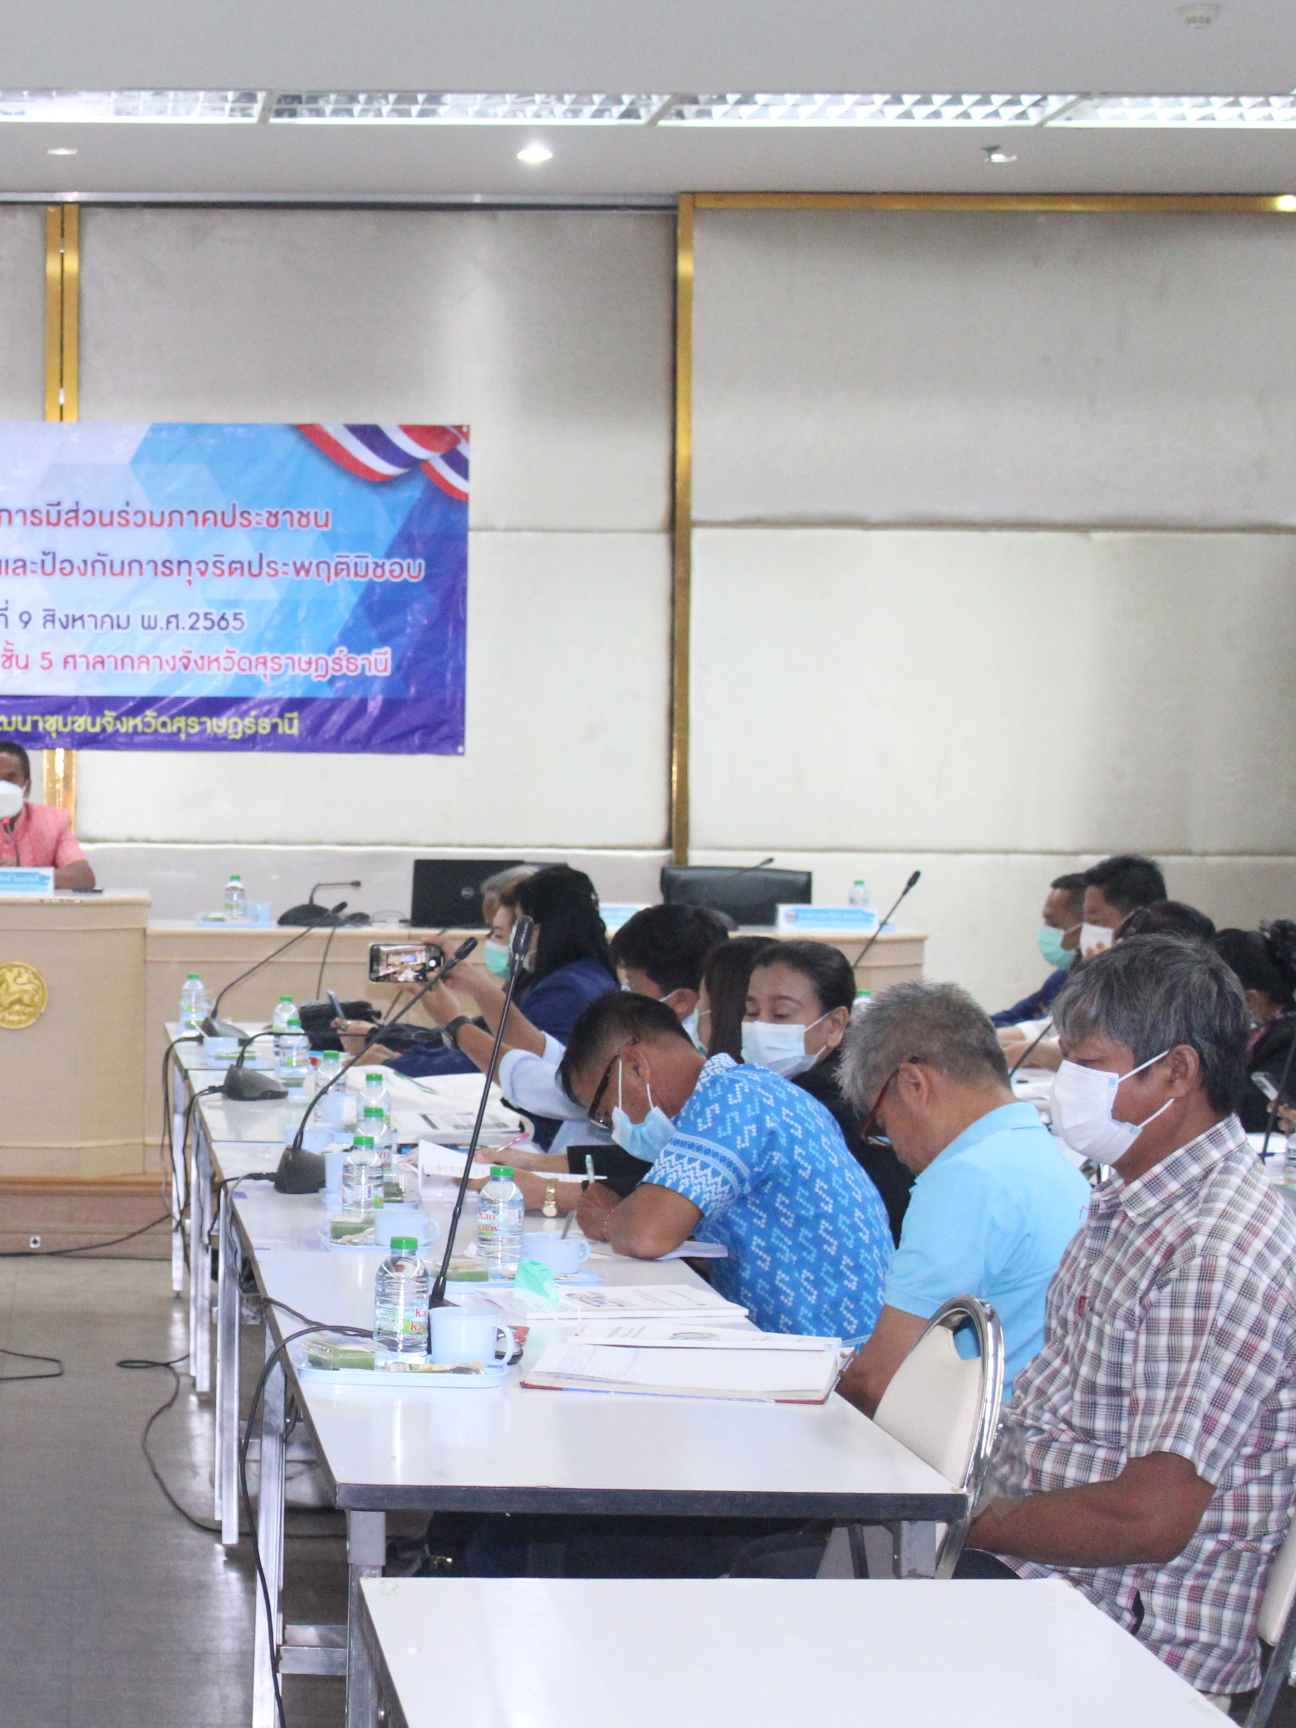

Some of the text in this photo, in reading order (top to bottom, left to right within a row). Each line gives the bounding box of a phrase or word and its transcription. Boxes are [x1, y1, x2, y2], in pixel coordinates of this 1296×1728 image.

[19, 611, 32, 629] 9
[43, 608, 131, 631] สิงหาคม
[141, 611, 246, 632] พ.ศ.2565
[0, 641, 29, 671] ชั้น
[40, 652, 53, 670] 5
[63, 647, 391, 680] ศาลากลางจังหวัดสุราษฎร์ธานี
